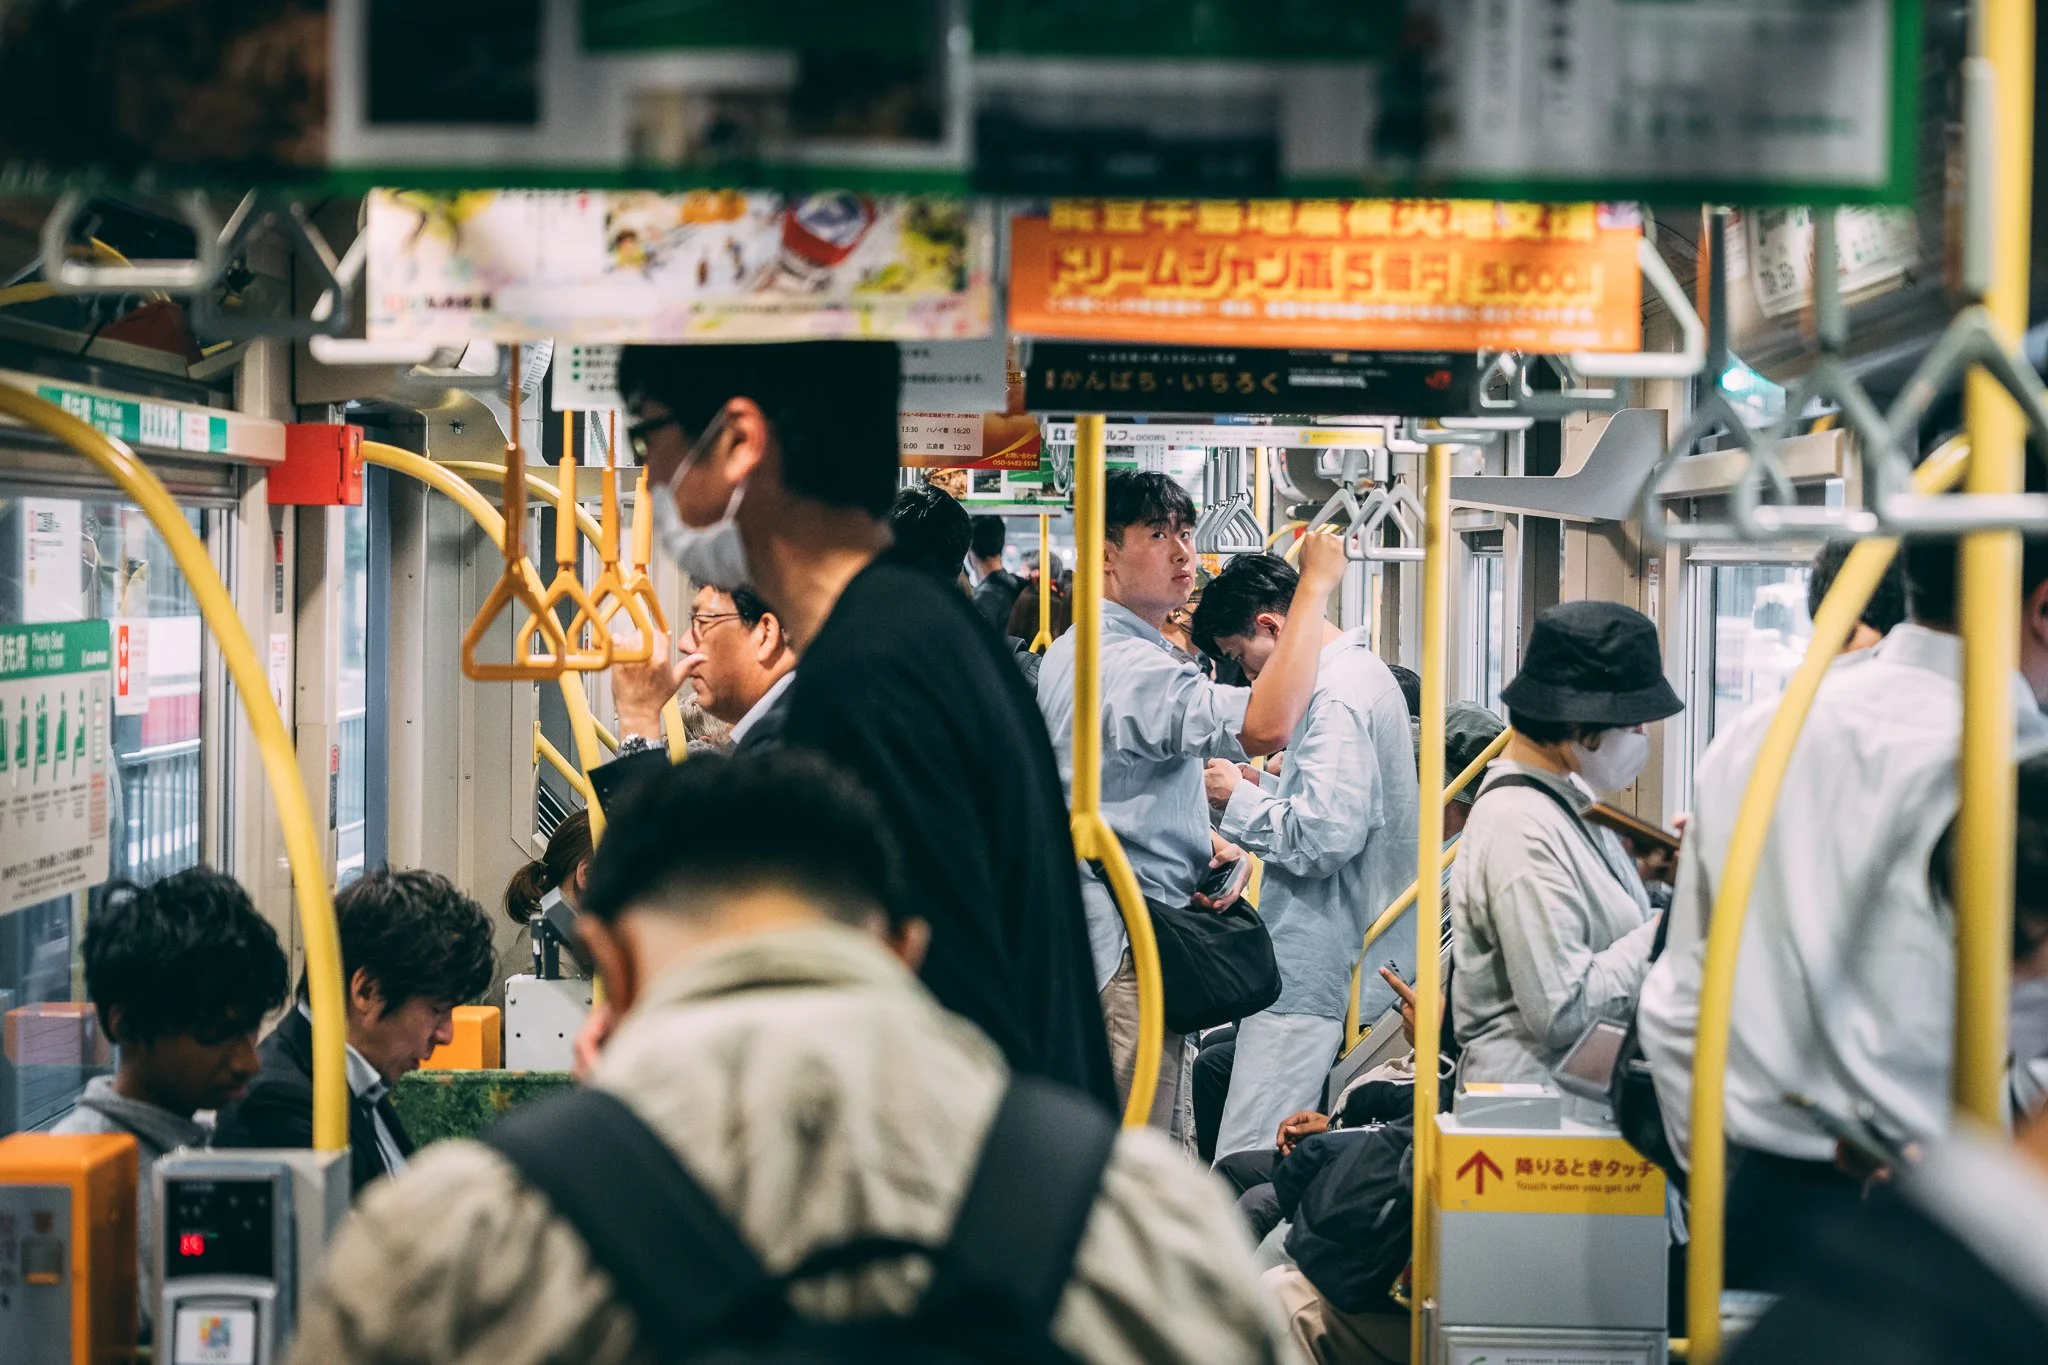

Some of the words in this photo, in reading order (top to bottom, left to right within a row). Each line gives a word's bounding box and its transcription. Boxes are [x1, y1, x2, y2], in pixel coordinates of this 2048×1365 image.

[953, 427, 971, 435] 16:20
[953, 443, 971, 451] 12:30
[1515, 1156, 1655, 1178] 降りるときタッチ
[1517, 1180, 1548, 1192] Touch
[1551, 1181, 1580, 1192] when
[1583, 1183, 1601, 1194] you
[1604, 1182, 1622, 1194] get
[1624, 1182, 1641, 1193] off
